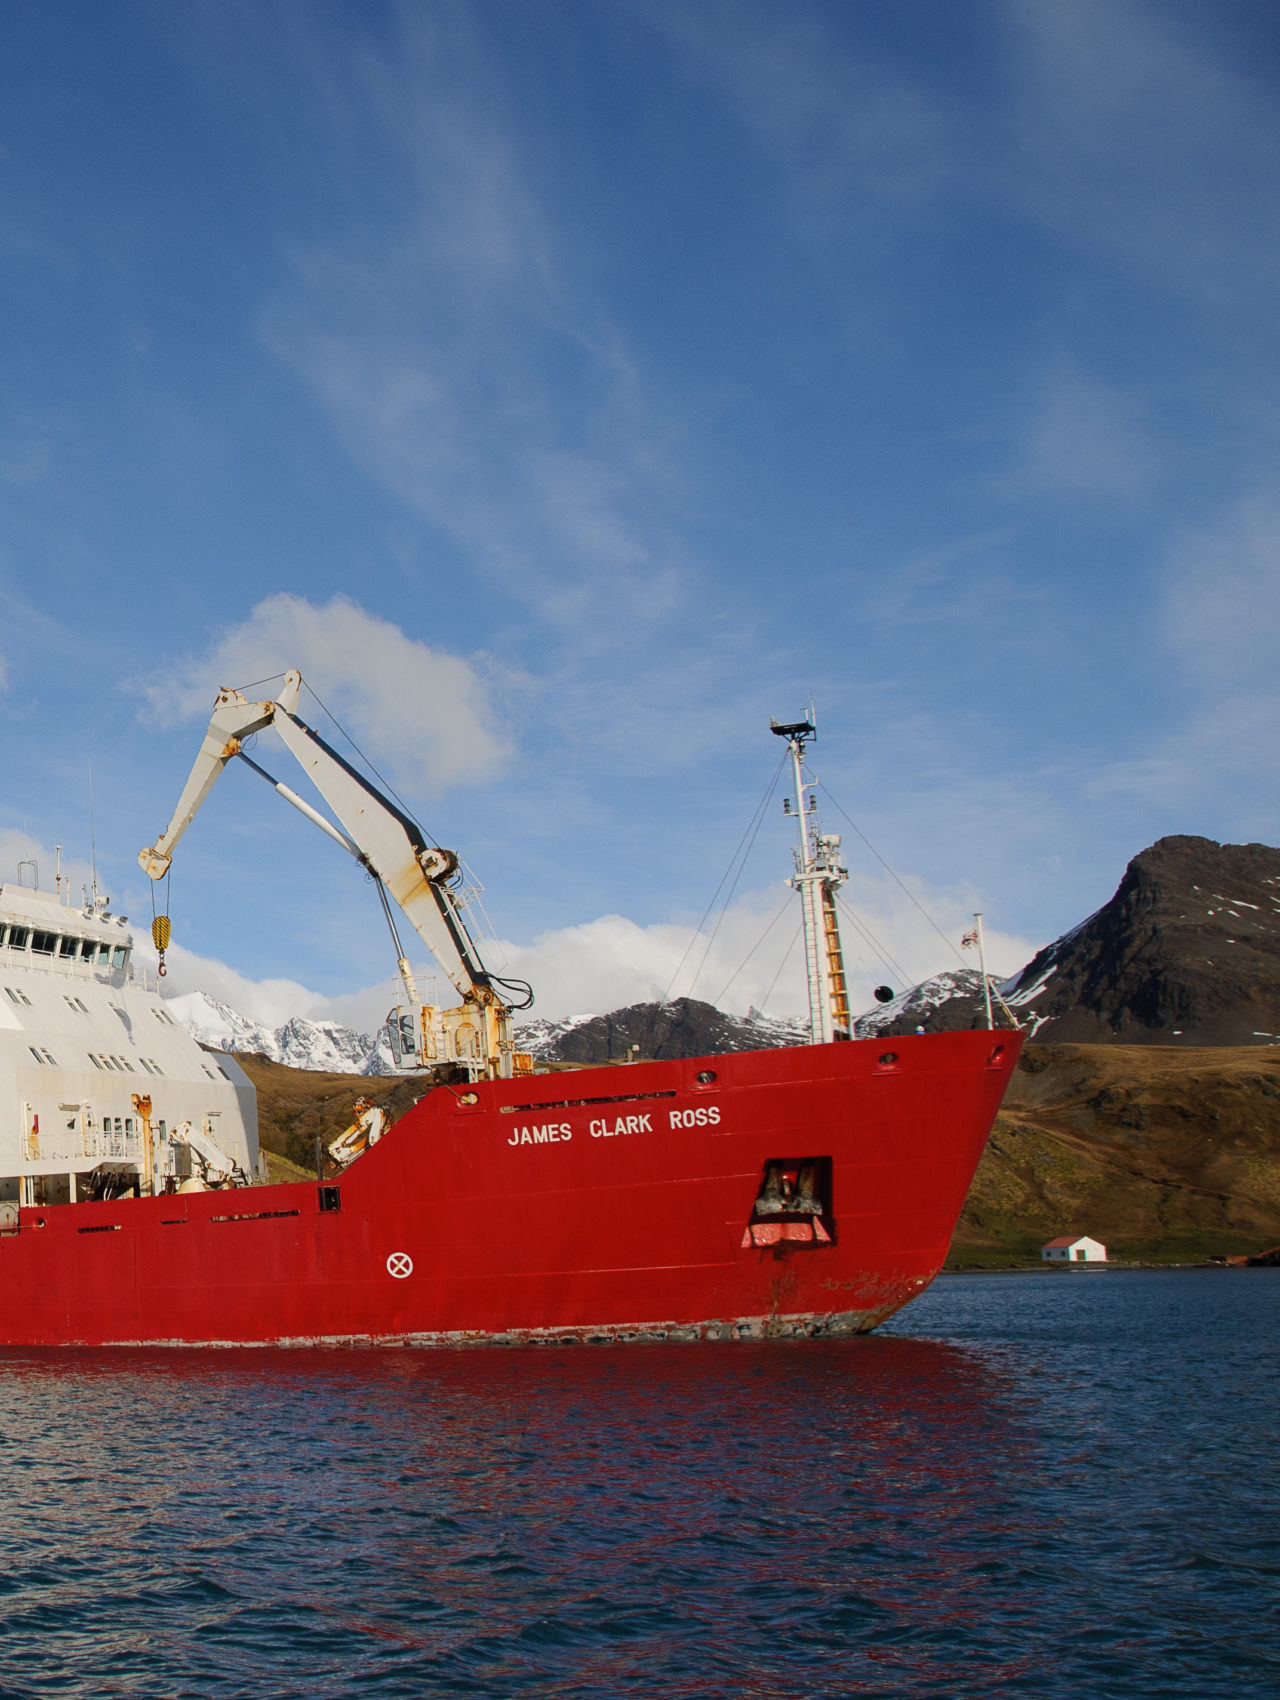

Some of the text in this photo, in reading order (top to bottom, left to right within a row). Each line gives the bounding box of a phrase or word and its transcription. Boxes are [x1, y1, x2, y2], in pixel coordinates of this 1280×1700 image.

[507, 1106, 721, 1146] JAMES CLARK ROSS
